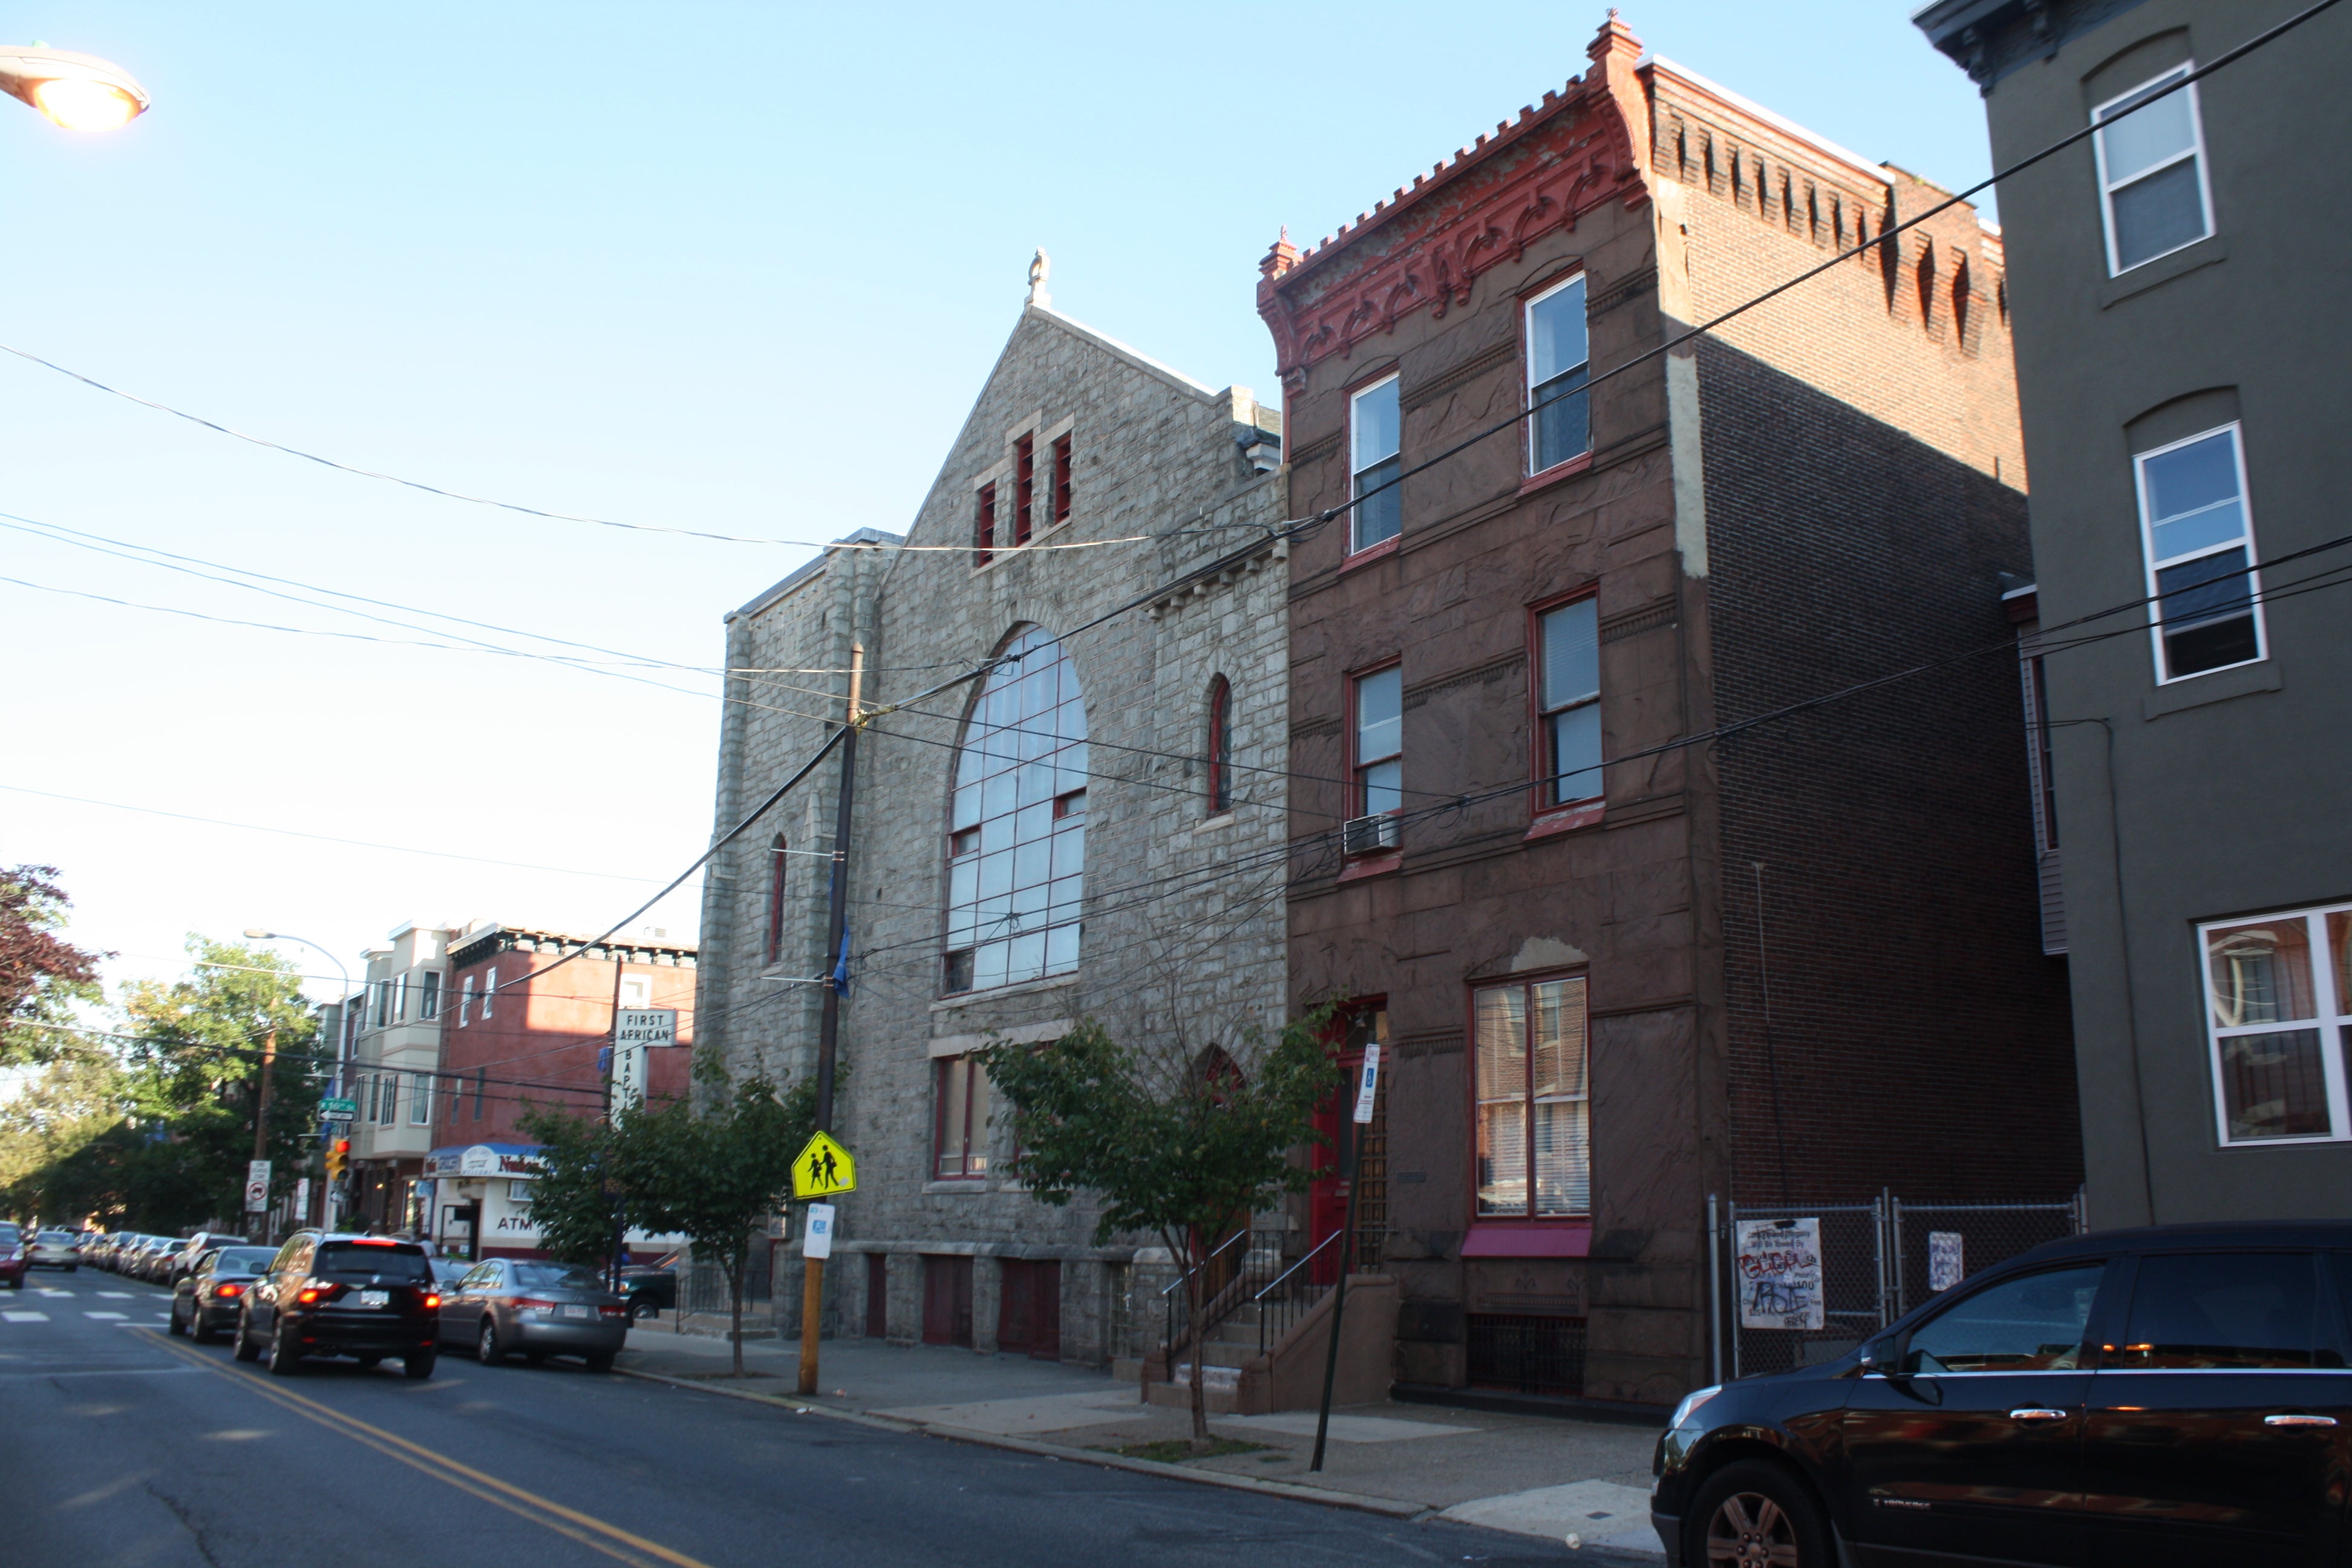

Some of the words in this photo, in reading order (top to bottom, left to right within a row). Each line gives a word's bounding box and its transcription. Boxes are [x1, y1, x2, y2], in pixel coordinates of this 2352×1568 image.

[627, 1015, 664, 1025] FIRST
[620, 1030, 669, 1040] AFRICAN
[624, 1050, 632, 1111] BAPTI
[497, 1217, 533, 1230] ATM
